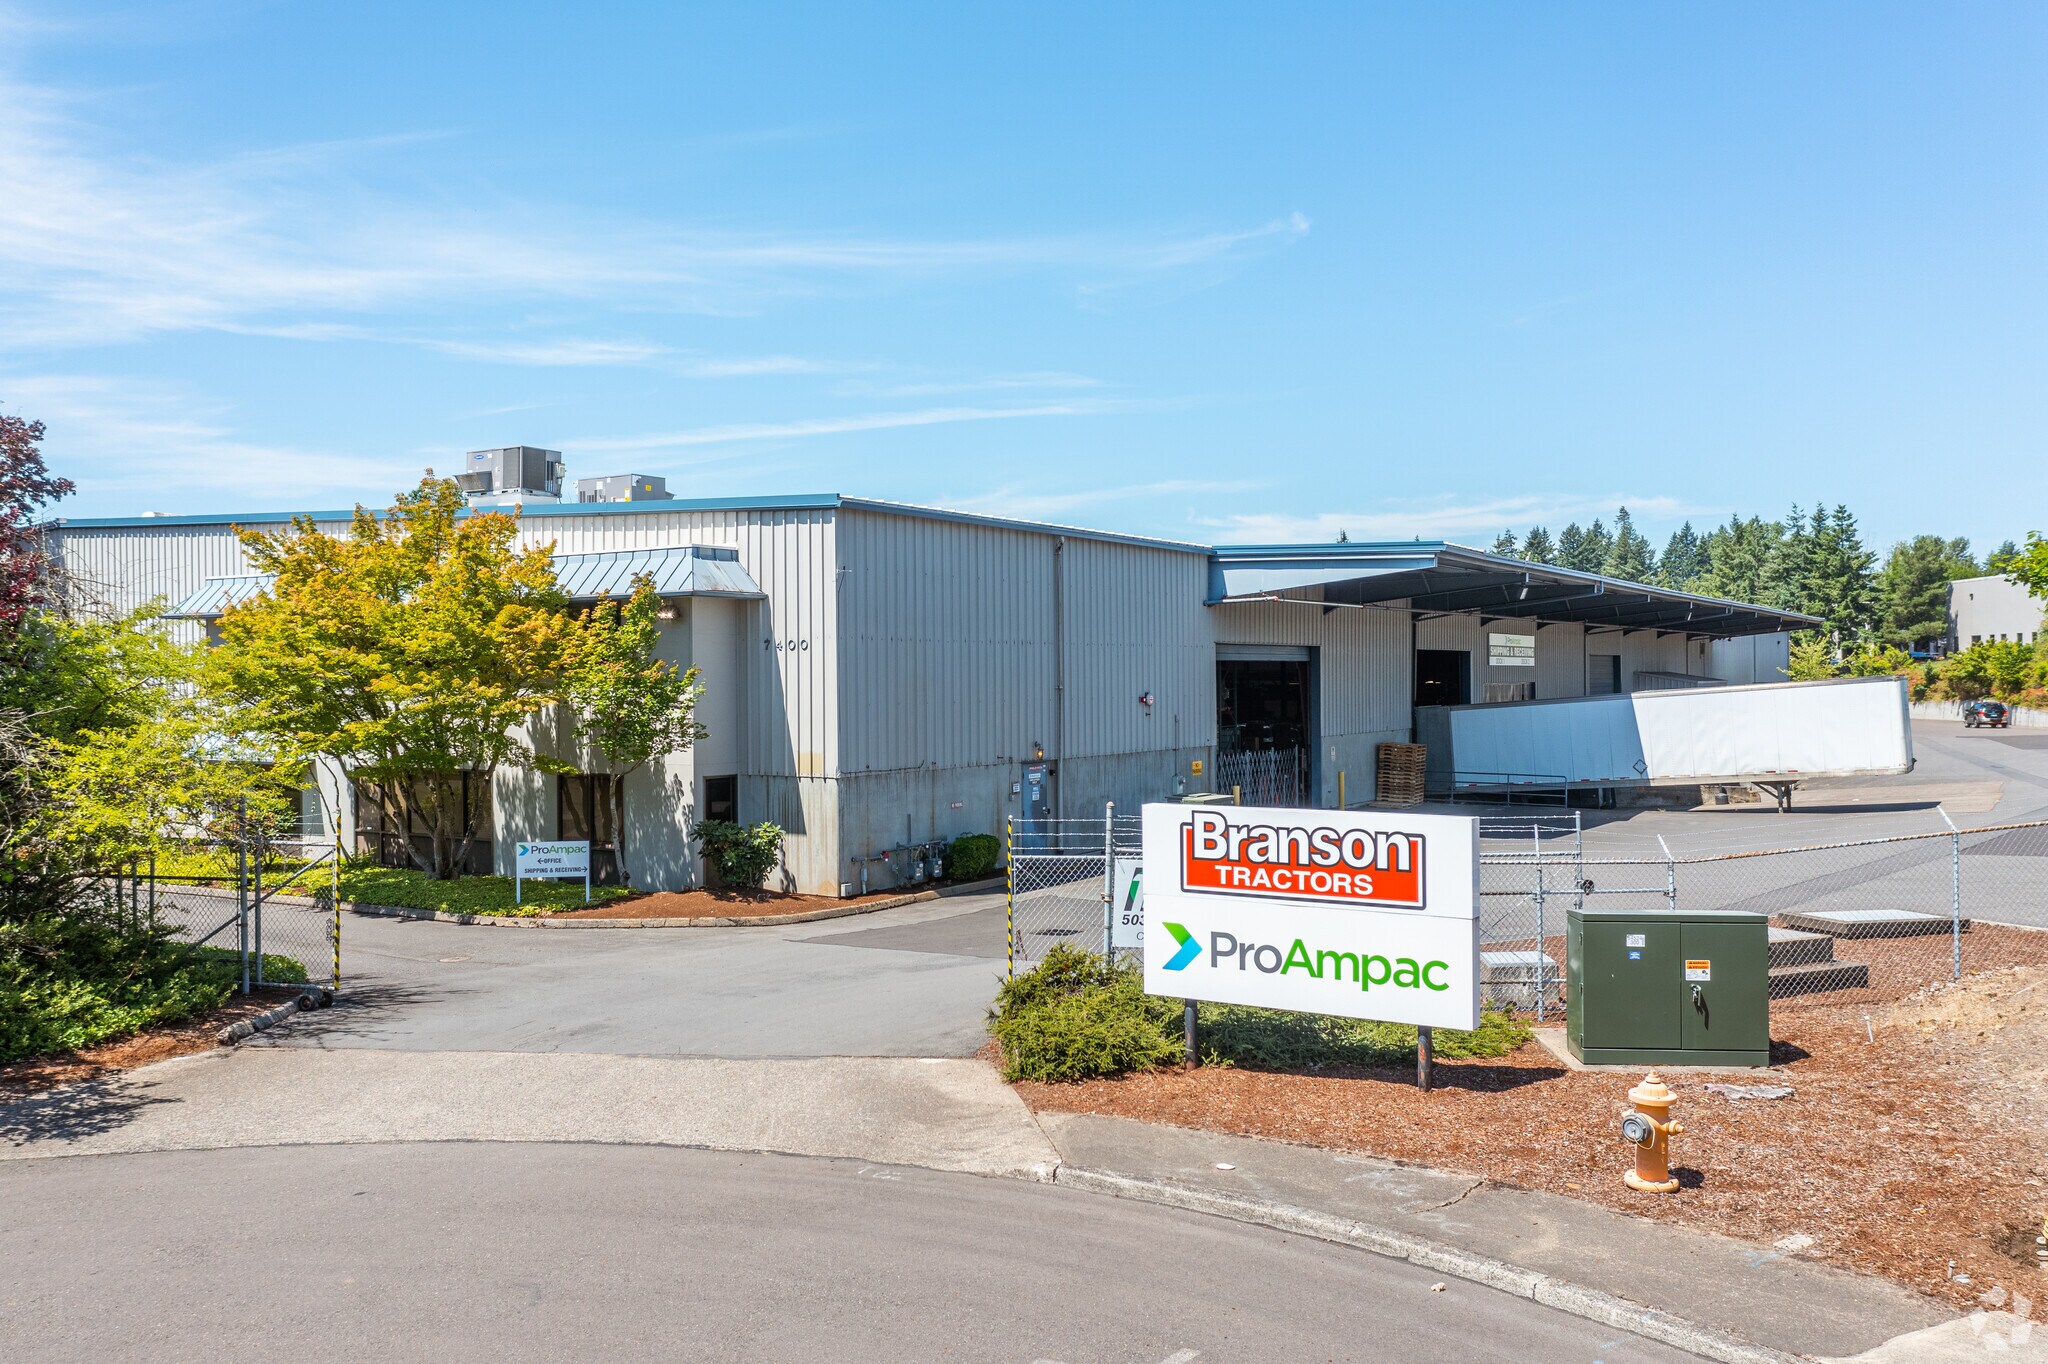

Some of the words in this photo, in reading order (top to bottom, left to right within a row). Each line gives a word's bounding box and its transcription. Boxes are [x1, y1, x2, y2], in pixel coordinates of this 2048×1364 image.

[764, 639, 808, 651] 7400
[531, 845, 586, 854] ProAmpac
[1192, 810, 1412, 872] Branson
[1215, 864, 1373, 895] TRACTORS
[1210, 930, 1450, 992] ProAmpac
